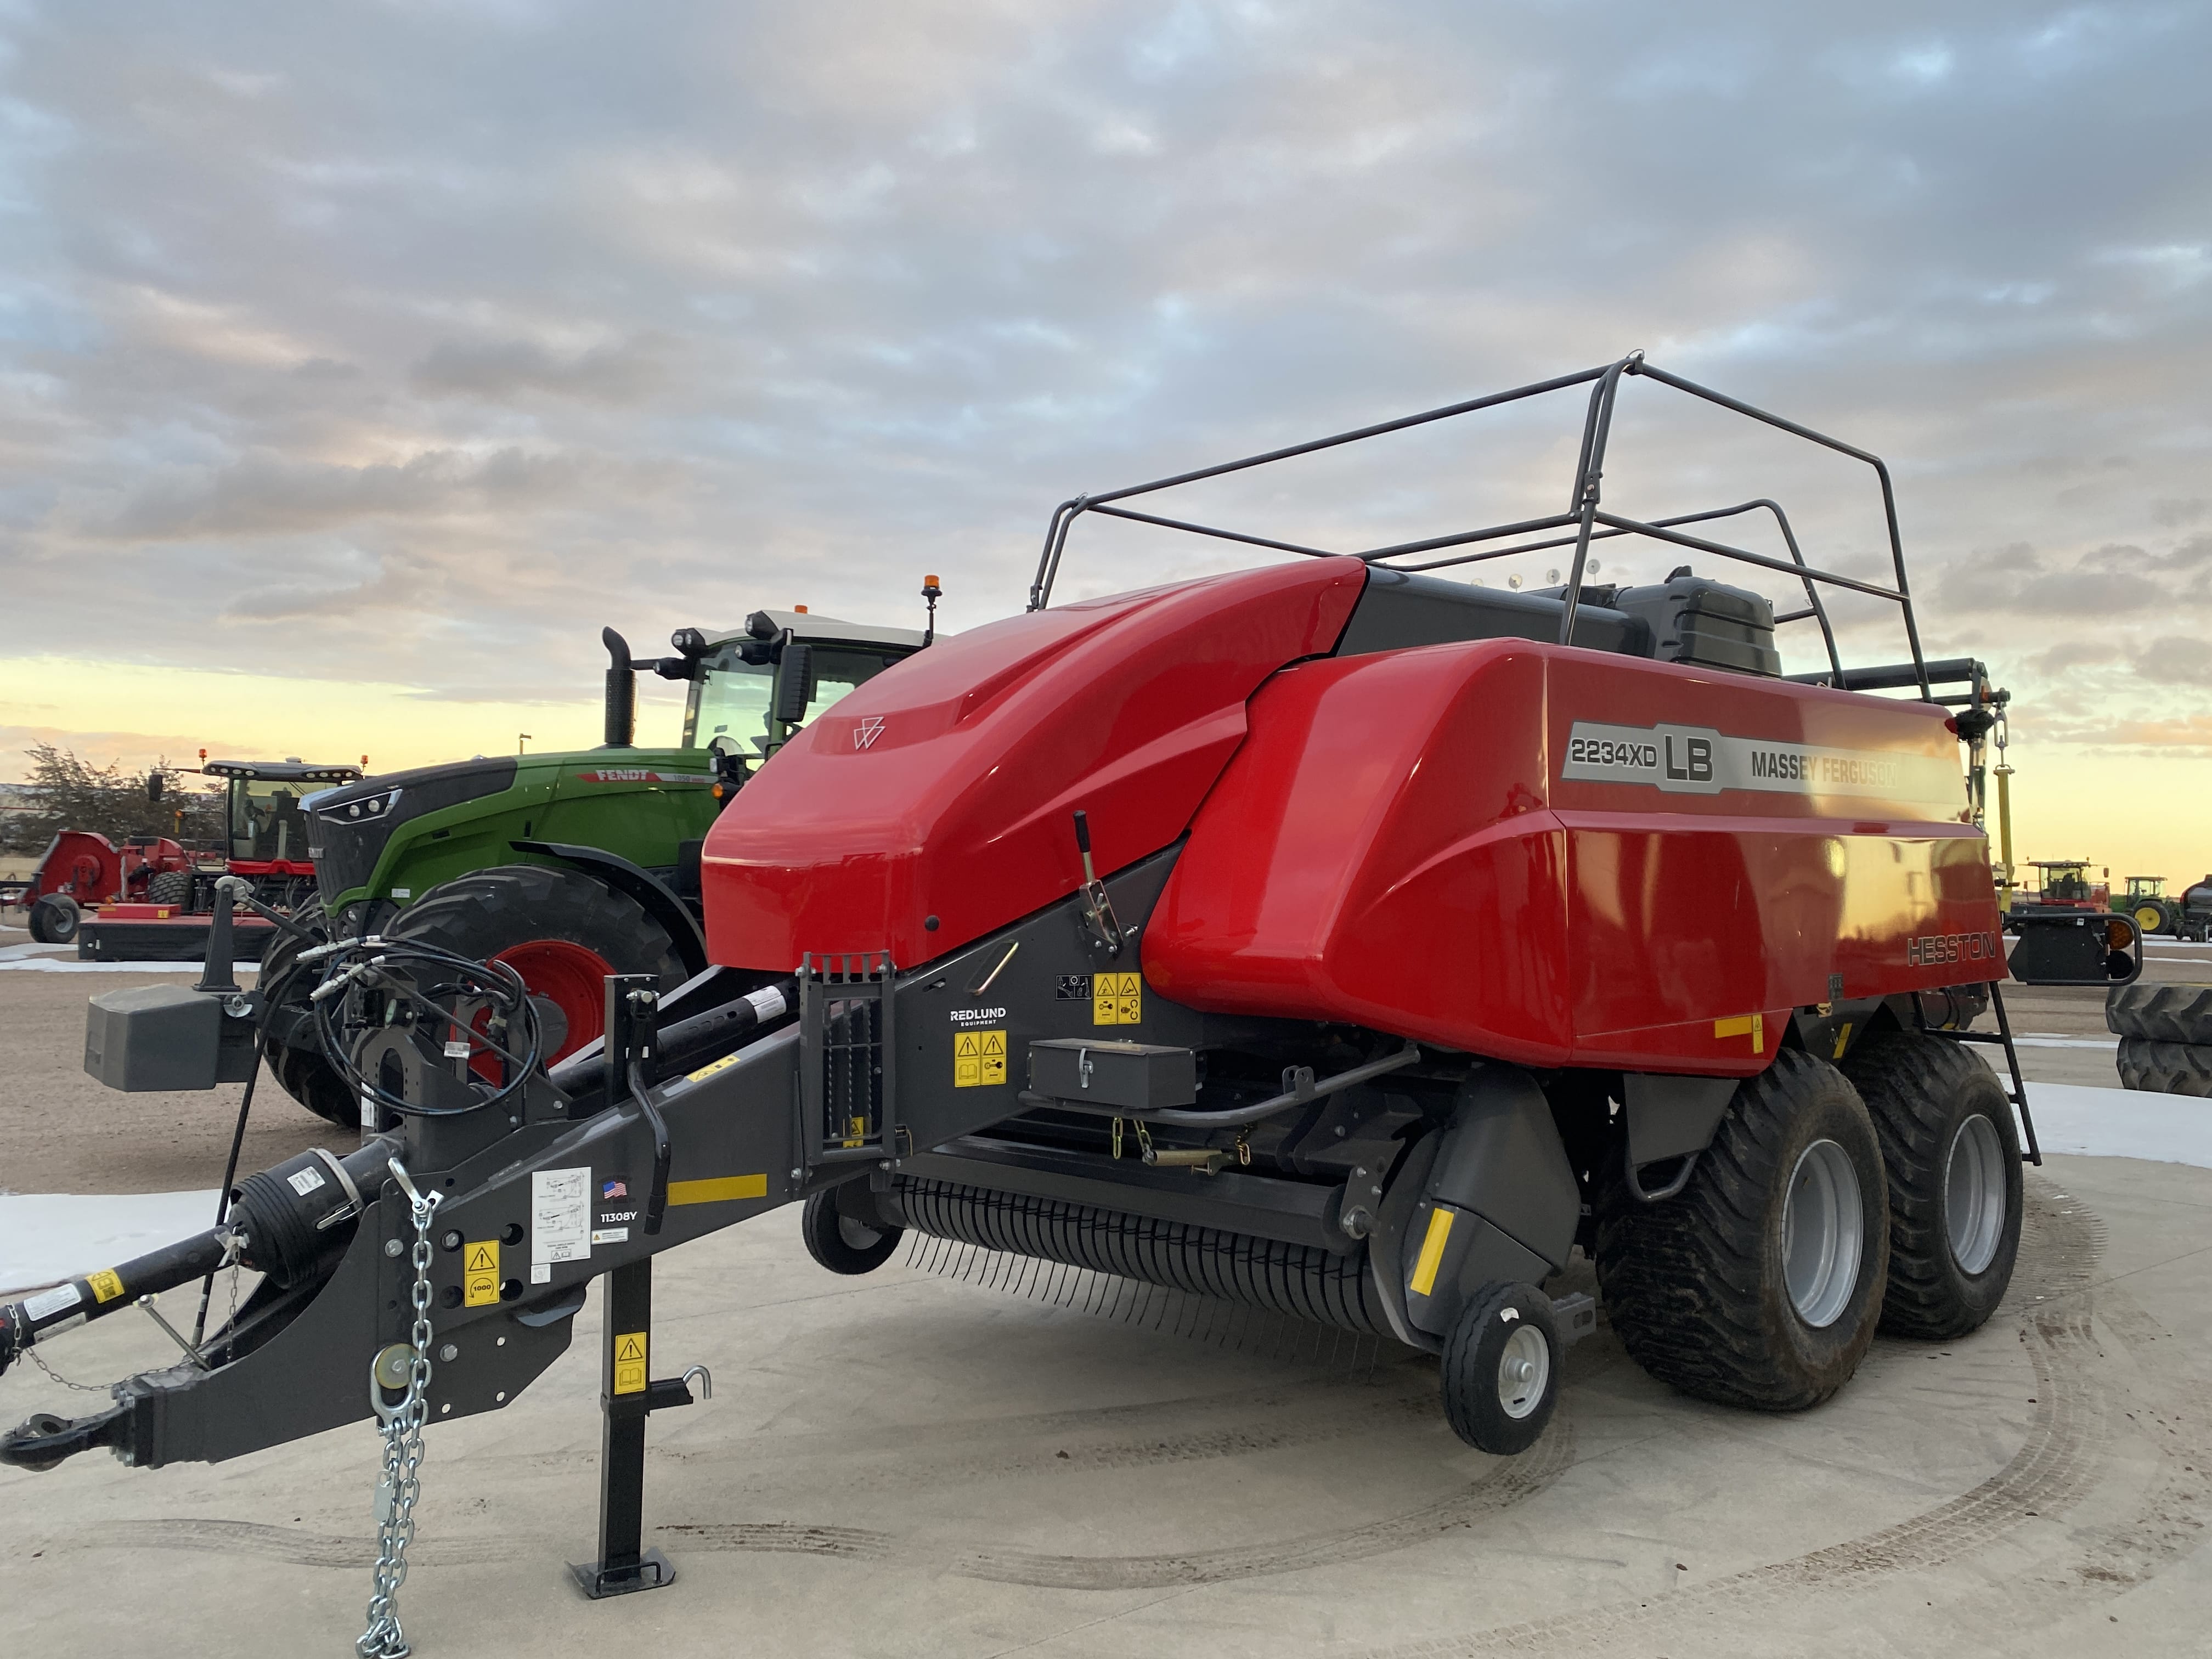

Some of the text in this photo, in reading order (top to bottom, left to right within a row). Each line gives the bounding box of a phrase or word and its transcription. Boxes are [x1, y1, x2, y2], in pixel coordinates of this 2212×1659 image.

[1571, 734, 1713, 783] 2234XD LB
[1752, 751, 1897, 788] MASSEY FERGUSON
[596, 770, 648, 781] FENDT
[1908, 931, 1995, 967] HESSTON
[950, 1007, 1006, 1021] REDLUND
[601, 1211, 637, 1223] 11308Y
